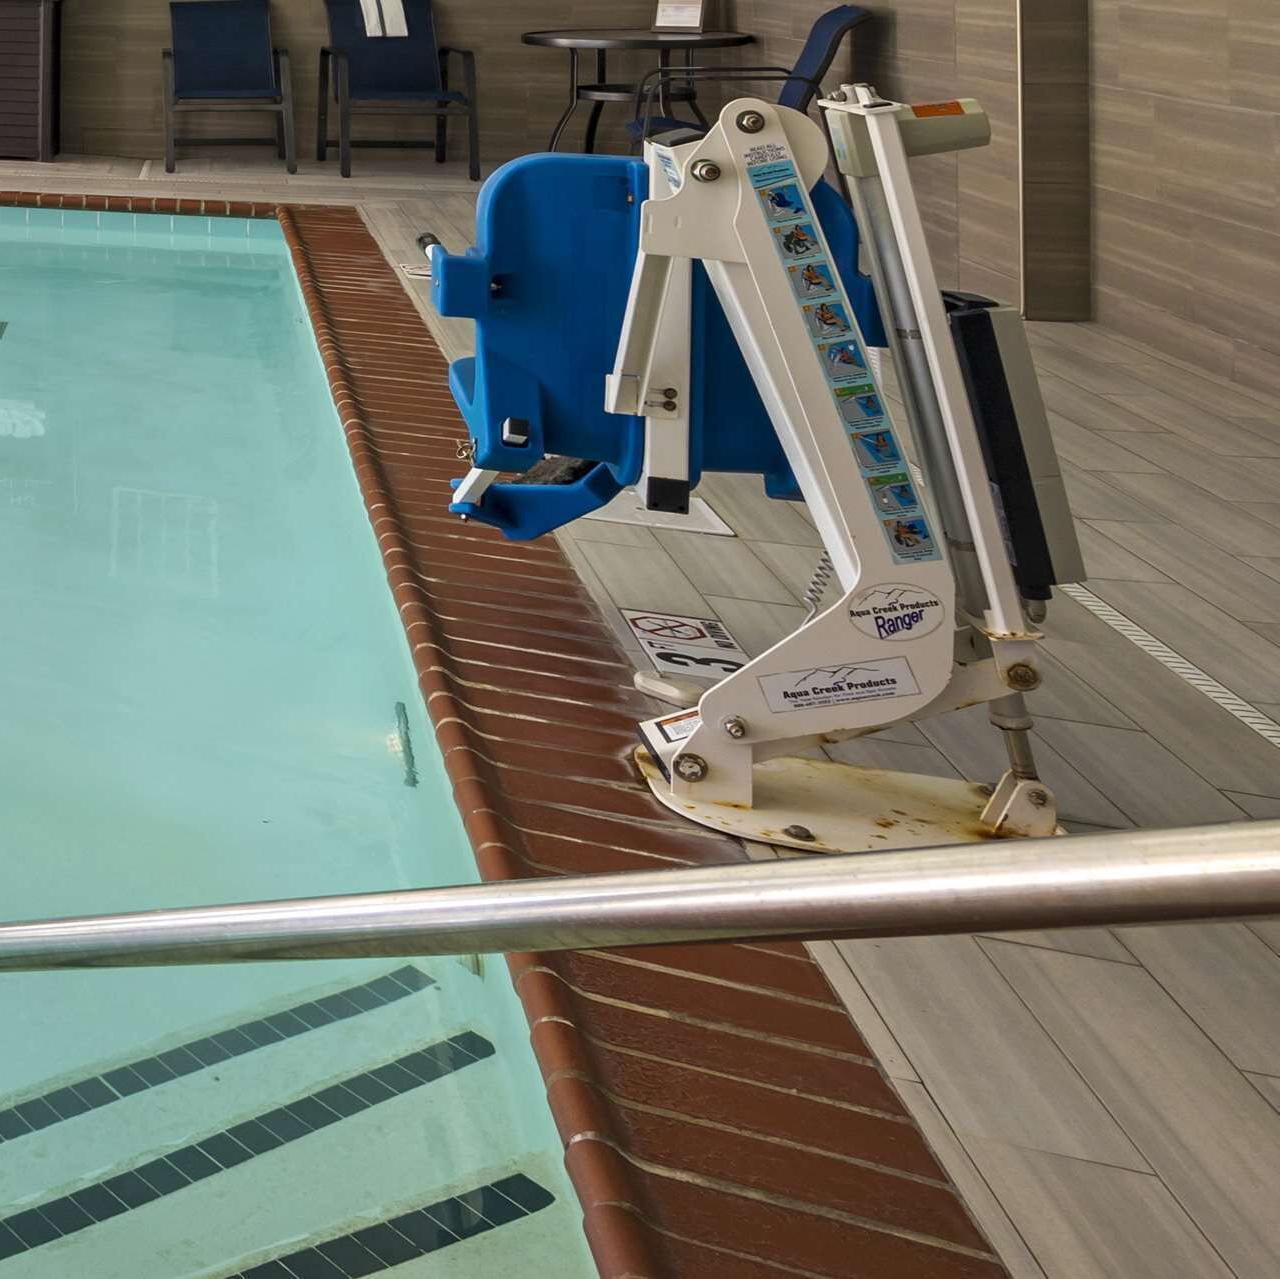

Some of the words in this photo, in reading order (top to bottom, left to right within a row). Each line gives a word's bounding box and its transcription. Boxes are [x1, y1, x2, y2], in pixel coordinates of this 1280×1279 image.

[849, 609, 871, 618] Aqua
[872, 604, 898, 615] Creek
[899, 600, 939, 611] Products
[874, 609, 925, 640] Ranger
[655, 651, 745, 673] 3
[783, 690, 810, 700] Aqua
[812, 684, 844, 697] Creek
[847, 677, 897, 691] Products
